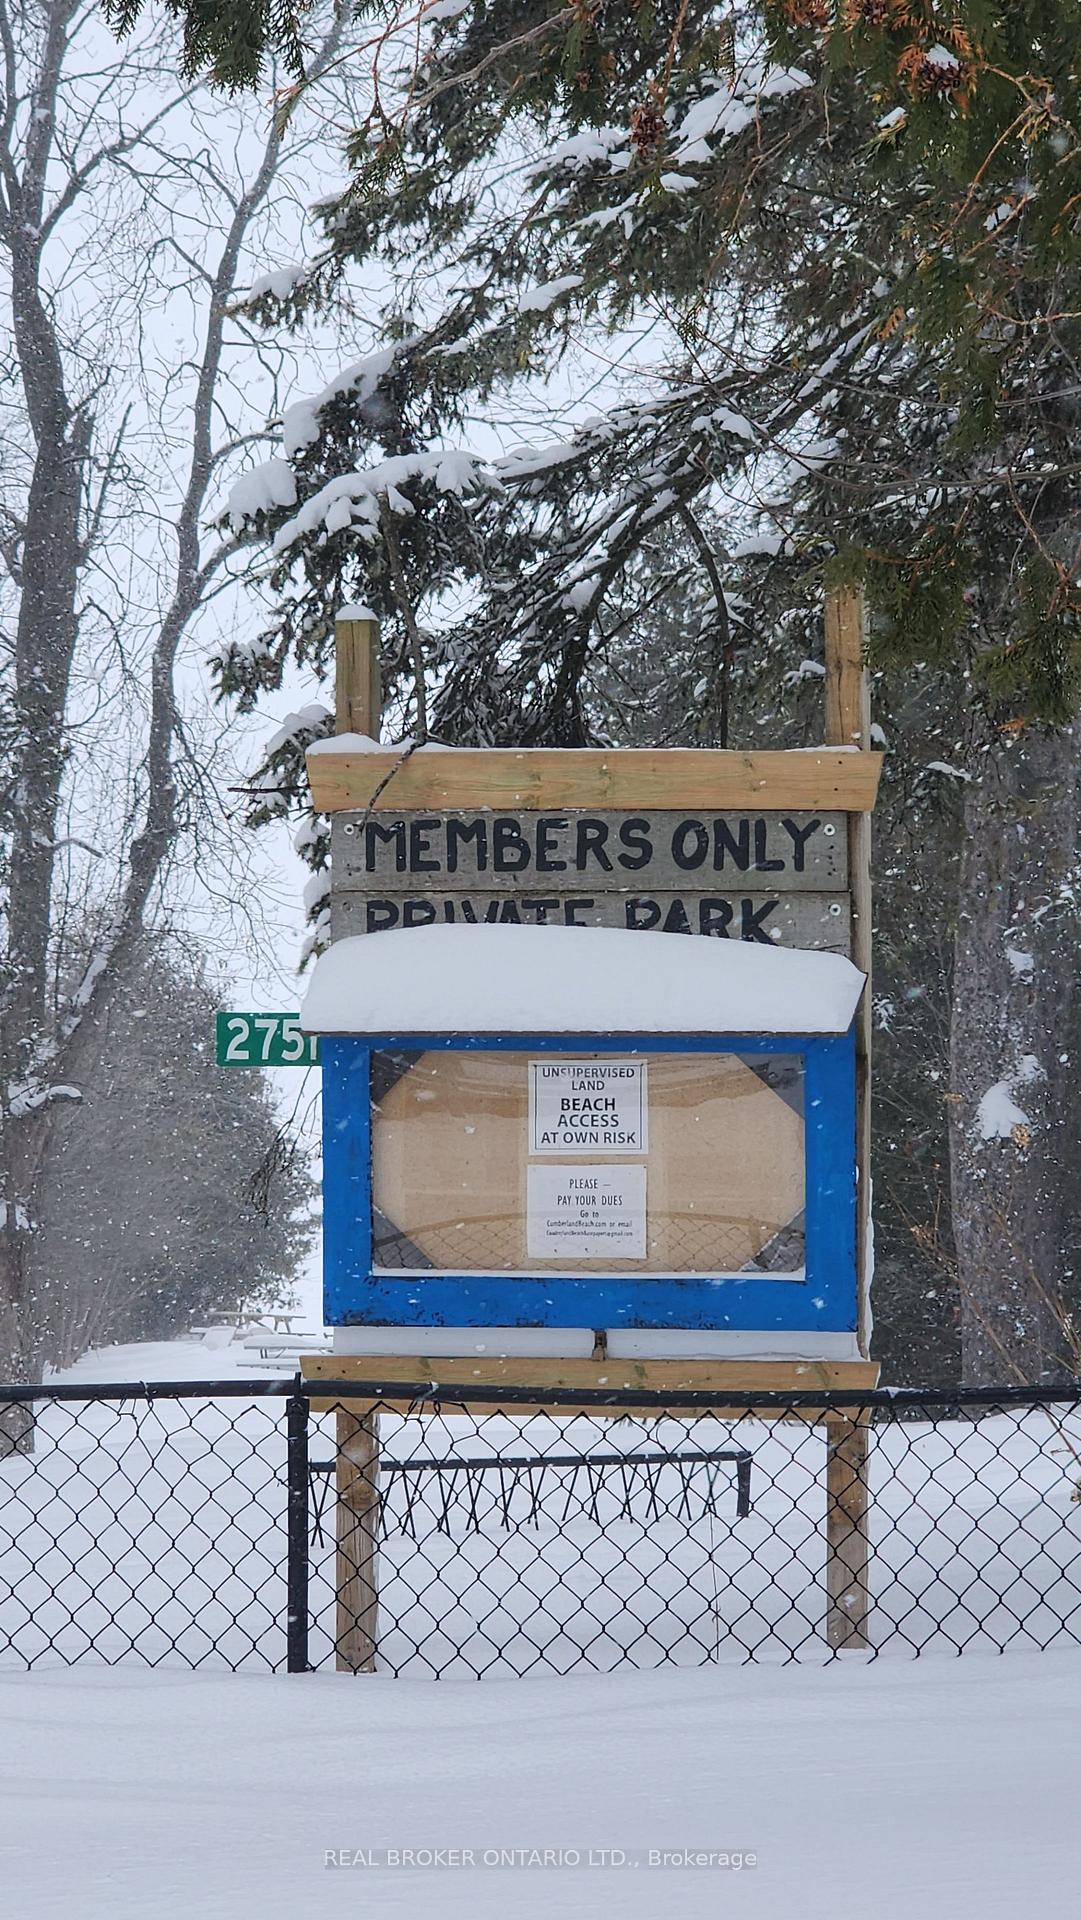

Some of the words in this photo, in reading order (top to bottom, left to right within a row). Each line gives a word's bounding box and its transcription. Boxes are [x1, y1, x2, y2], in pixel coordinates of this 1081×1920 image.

[365, 818, 653, 872] MEMBERS
[671, 818, 822, 872] ONLY
[542, 1067, 635, 1078] UNSUPERVISED
[571, 1080, 605, 1091] LAND
[561, 1098, 616, 1111] BEACH
[557, 1114, 619, 1127] ACCESS
[541, 1132, 559, 1144] AT
[563, 1132, 599, 1144] OWN
[603, 1132, 636, 1144] RISK
[569, 1178, 598, 1189] PLEASE
[557, 1195, 572, 1206] PAY
[575, 1195, 597, 1206] YOUR
[601, 1195, 623, 1206] DUES
[580, 1209, 589, 1218] Go
